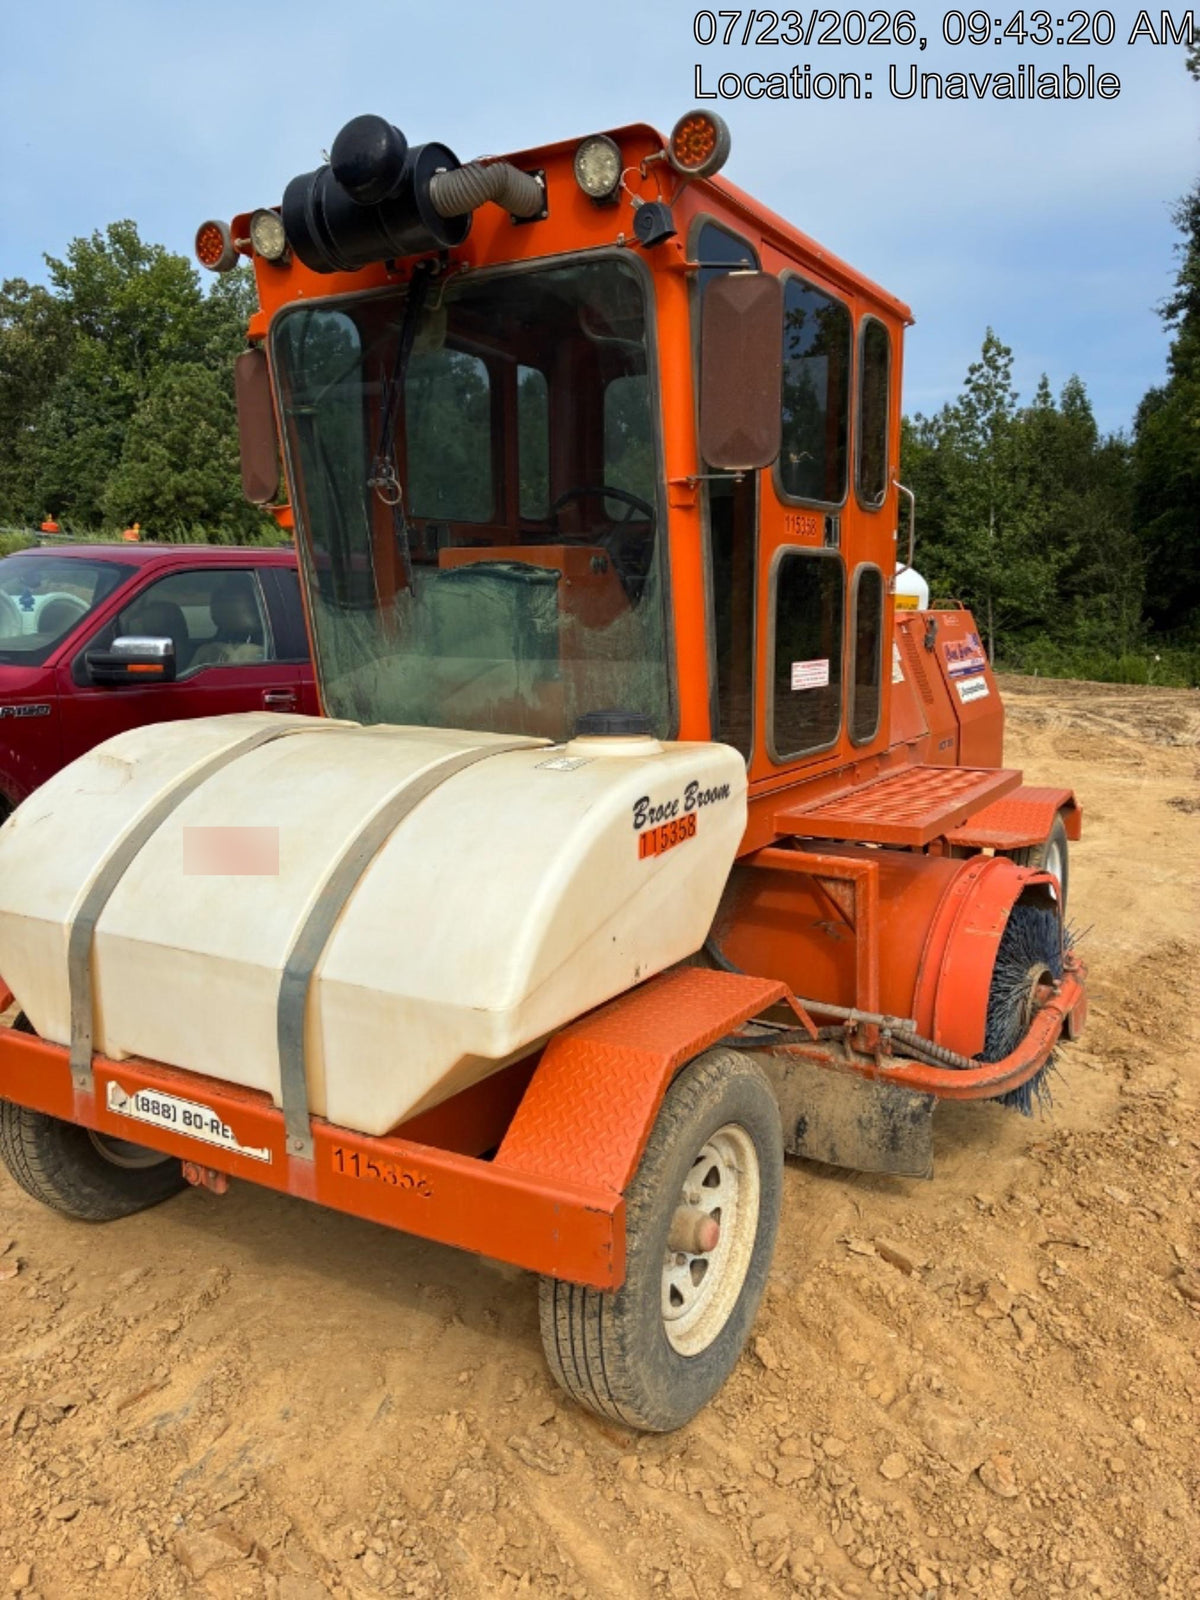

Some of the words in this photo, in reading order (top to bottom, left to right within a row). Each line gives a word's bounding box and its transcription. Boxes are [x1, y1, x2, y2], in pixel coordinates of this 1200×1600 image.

[633, 796, 680, 830] Broce
[684, 780, 730, 813] Broom
[640, 813, 696, 858] 115358
[135, 1094, 177, 1122] (888)
[182, 1110, 235, 1141] 80-RE
